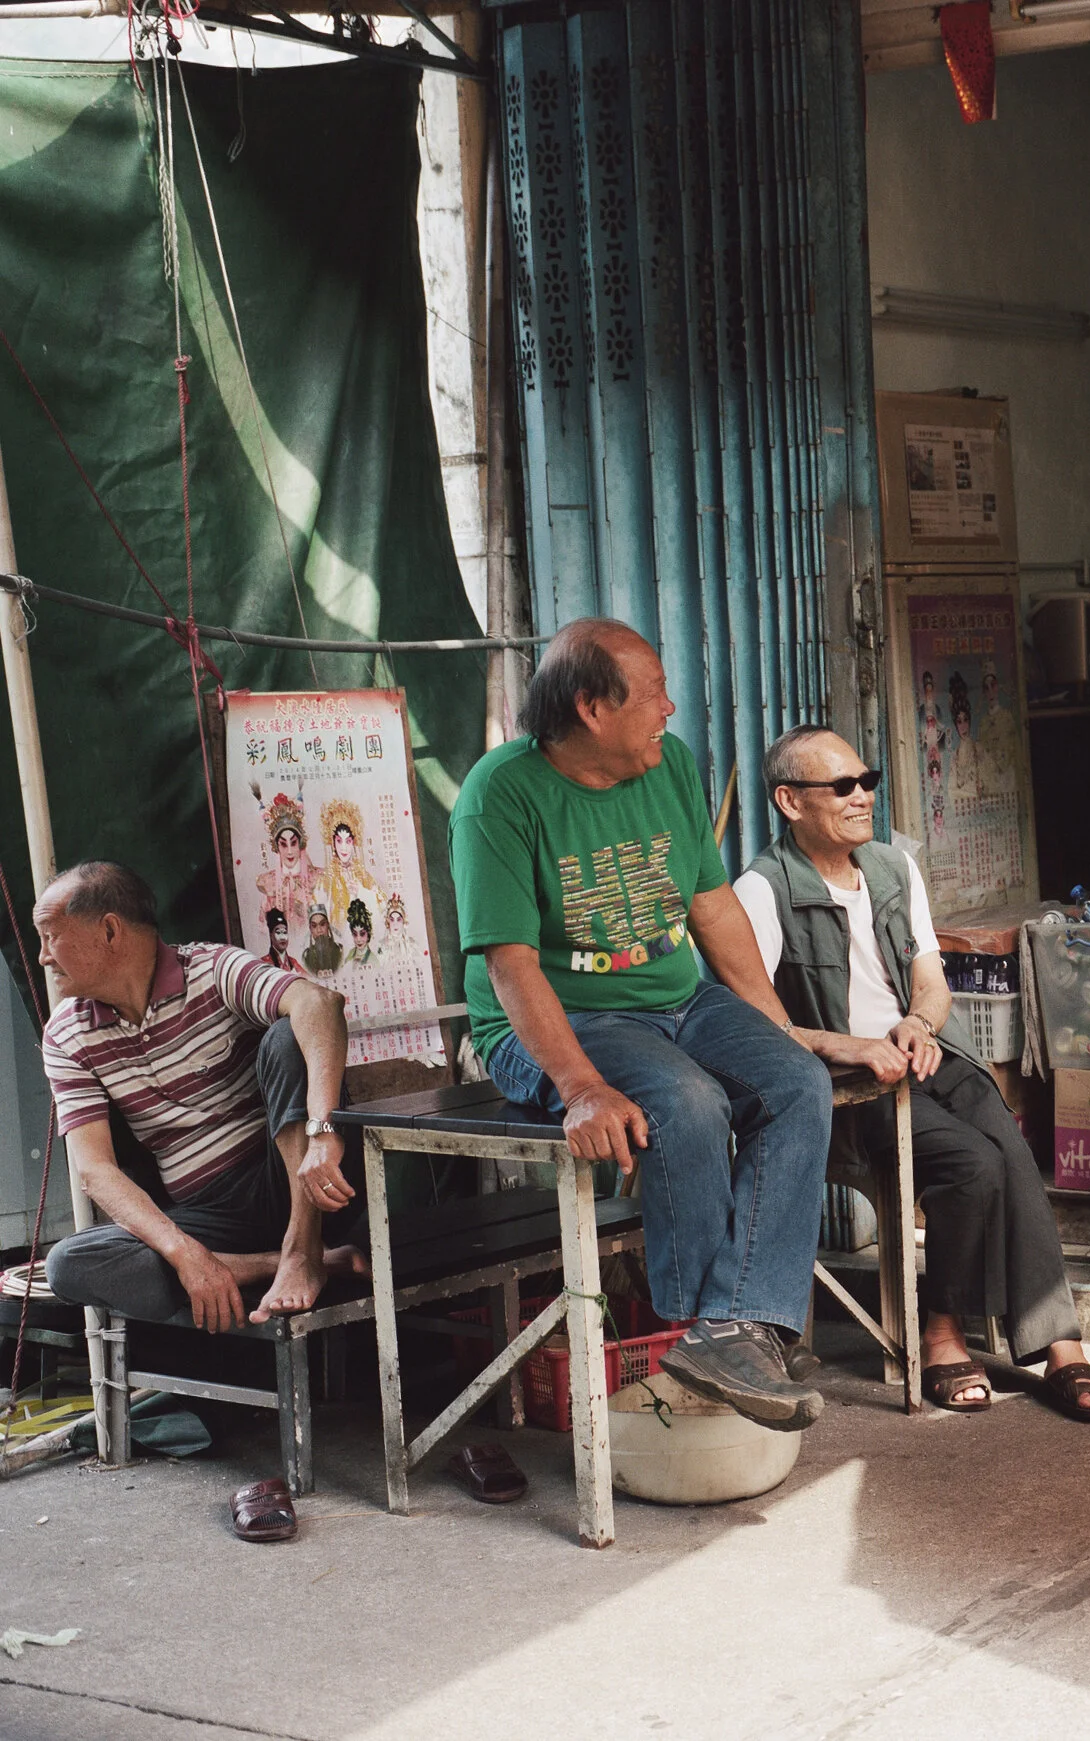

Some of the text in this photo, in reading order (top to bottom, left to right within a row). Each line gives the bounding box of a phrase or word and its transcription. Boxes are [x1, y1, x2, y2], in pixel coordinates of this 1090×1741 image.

[246, 734, 382, 766] 彩鳳鳴劇團
[571, 944, 648, 974] HONG
